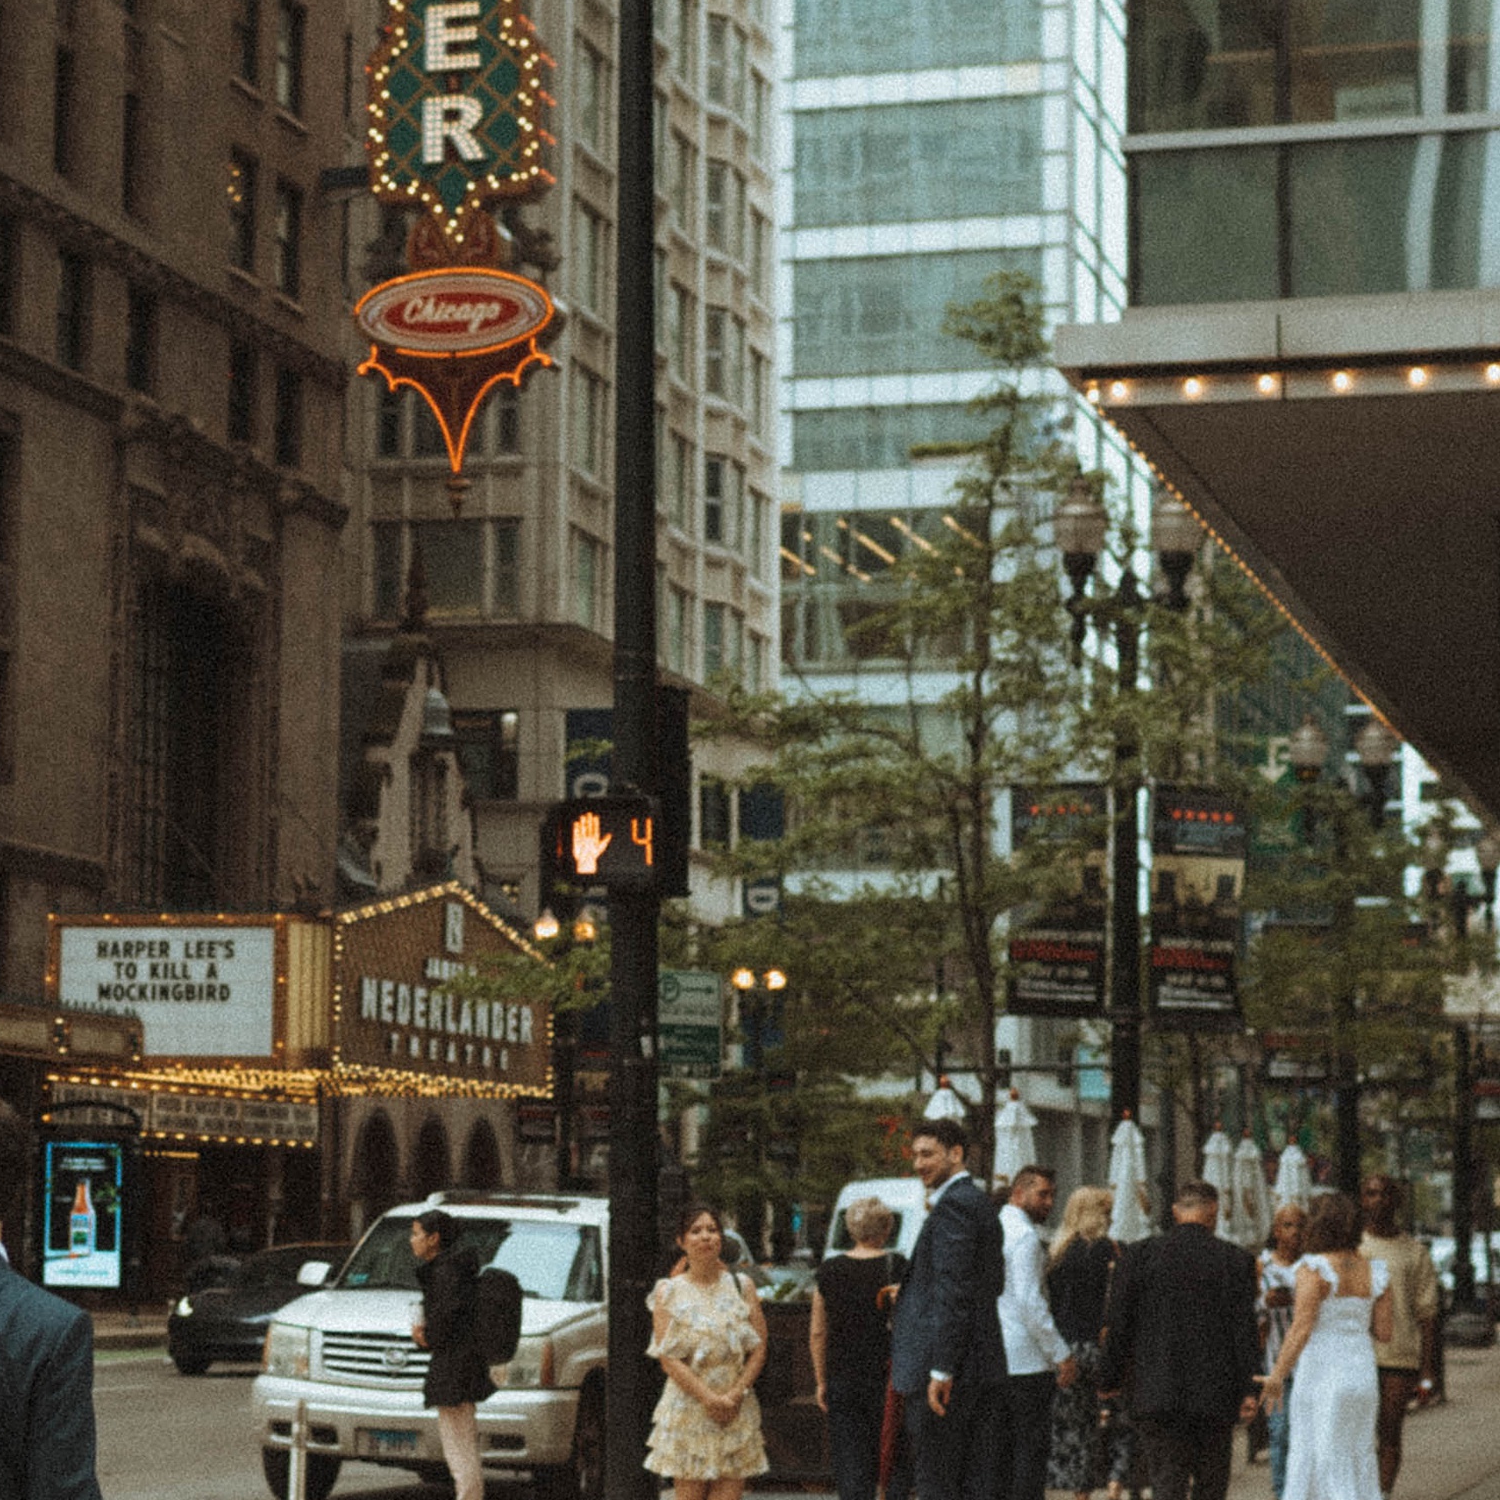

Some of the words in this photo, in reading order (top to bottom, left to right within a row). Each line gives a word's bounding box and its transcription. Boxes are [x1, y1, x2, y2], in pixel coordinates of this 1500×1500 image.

[403, 295, 501, 335] Chicago
[630, 817, 653, 866] 4
[97, 940, 170, 960] HARPER
[184, 940, 236, 959] LEE'S
[113, 962, 138, 980] TO
[150, 962, 192, 980] KILL
[206, 962, 218, 980] A
[98, 983, 231, 1002] MOCKINGBIRD
[361, 976, 534, 1044] NEDERLANDER
